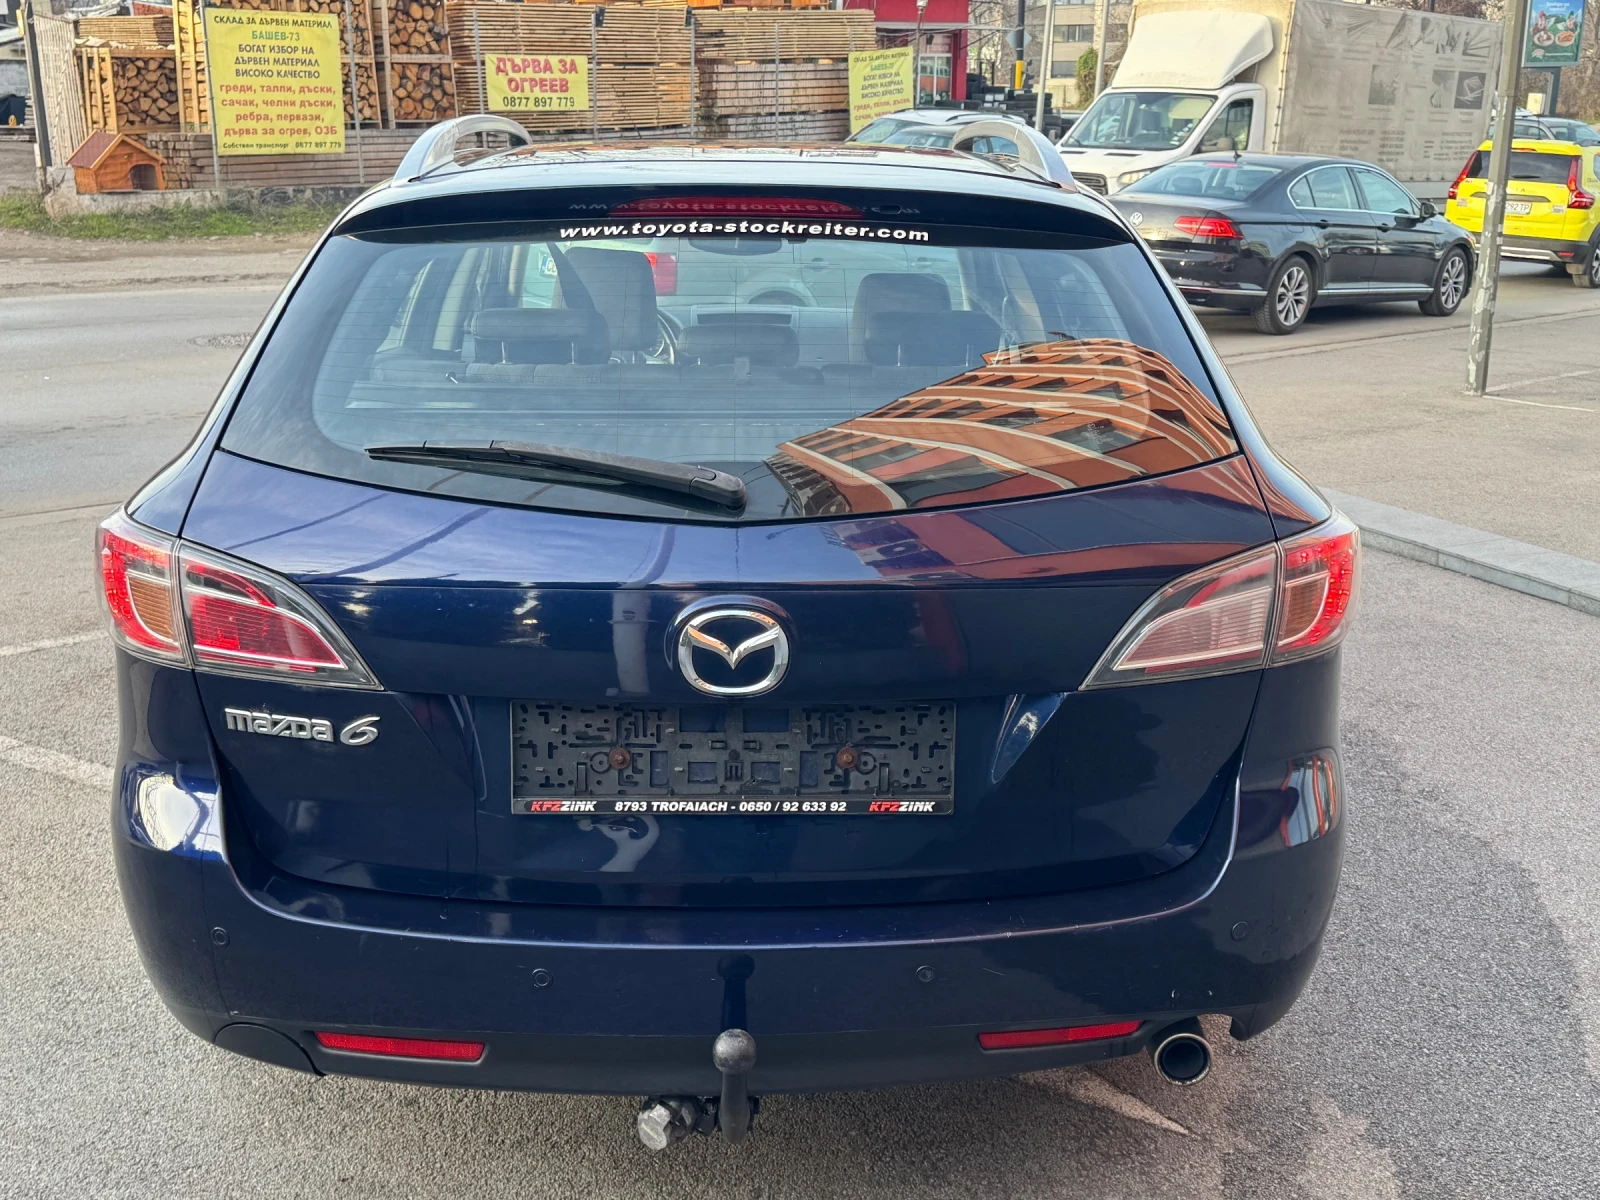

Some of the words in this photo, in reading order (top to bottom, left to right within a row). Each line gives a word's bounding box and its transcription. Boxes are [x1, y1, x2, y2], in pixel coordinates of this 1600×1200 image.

[214, 16, 244, 24] СКЛАД
[259, 18, 289, 26] ДЪРВЕН
[292, 19, 332, 28] МАТЕРИАЛ
[252, 31, 300, 41] БАШЕВ-73
[238, 44, 266, 53] БОГАТ
[269, 45, 298, 54] ИЗБОР
[302, 46, 314, 55] НА
[234, 57, 270, 65] ДЪРВЕН
[273, 58, 319, 67] МАТЕРИАЛ
[496, 57, 554, 76] ДЪРВА
[558, 58, 578, 74] ЗА
[236, 69, 273, 78] ВИСОКО
[277, 69, 320, 79] КАЧЕСТВО
[220, 84, 256, 94] греди,
[260, 85, 296, 94] талпи,
[299, 86, 335, 95] дъски,
[507, 77, 569, 93] ОГРЕЕВ
[221, 99, 259, 108] сачак,
[299, 100, 336, 109] дъски,
[503, 97, 530, 107] 0877
[534, 97, 553, 107] 897
[556, 97, 575, 107] 779
[236, 112, 273, 123] ребра,
[224, 128, 258, 137] дърва
[279, 127, 311, 137] огрев,
[315, 126, 337, 134] ОЗБ
[560, 221, 930, 242] www.toyota-stockreiter.com
[340, 716, 380, 746] 6
[614, 802, 648, 812] 8793
[651, 802, 728, 812] TROFAIACH
[739, 802, 772, 812] 0650
[774, 802, 780, 812] /
[782, 802, 800, 812] 92
[802, 802, 826, 812] 633
[830, 802, 847, 812] 92
